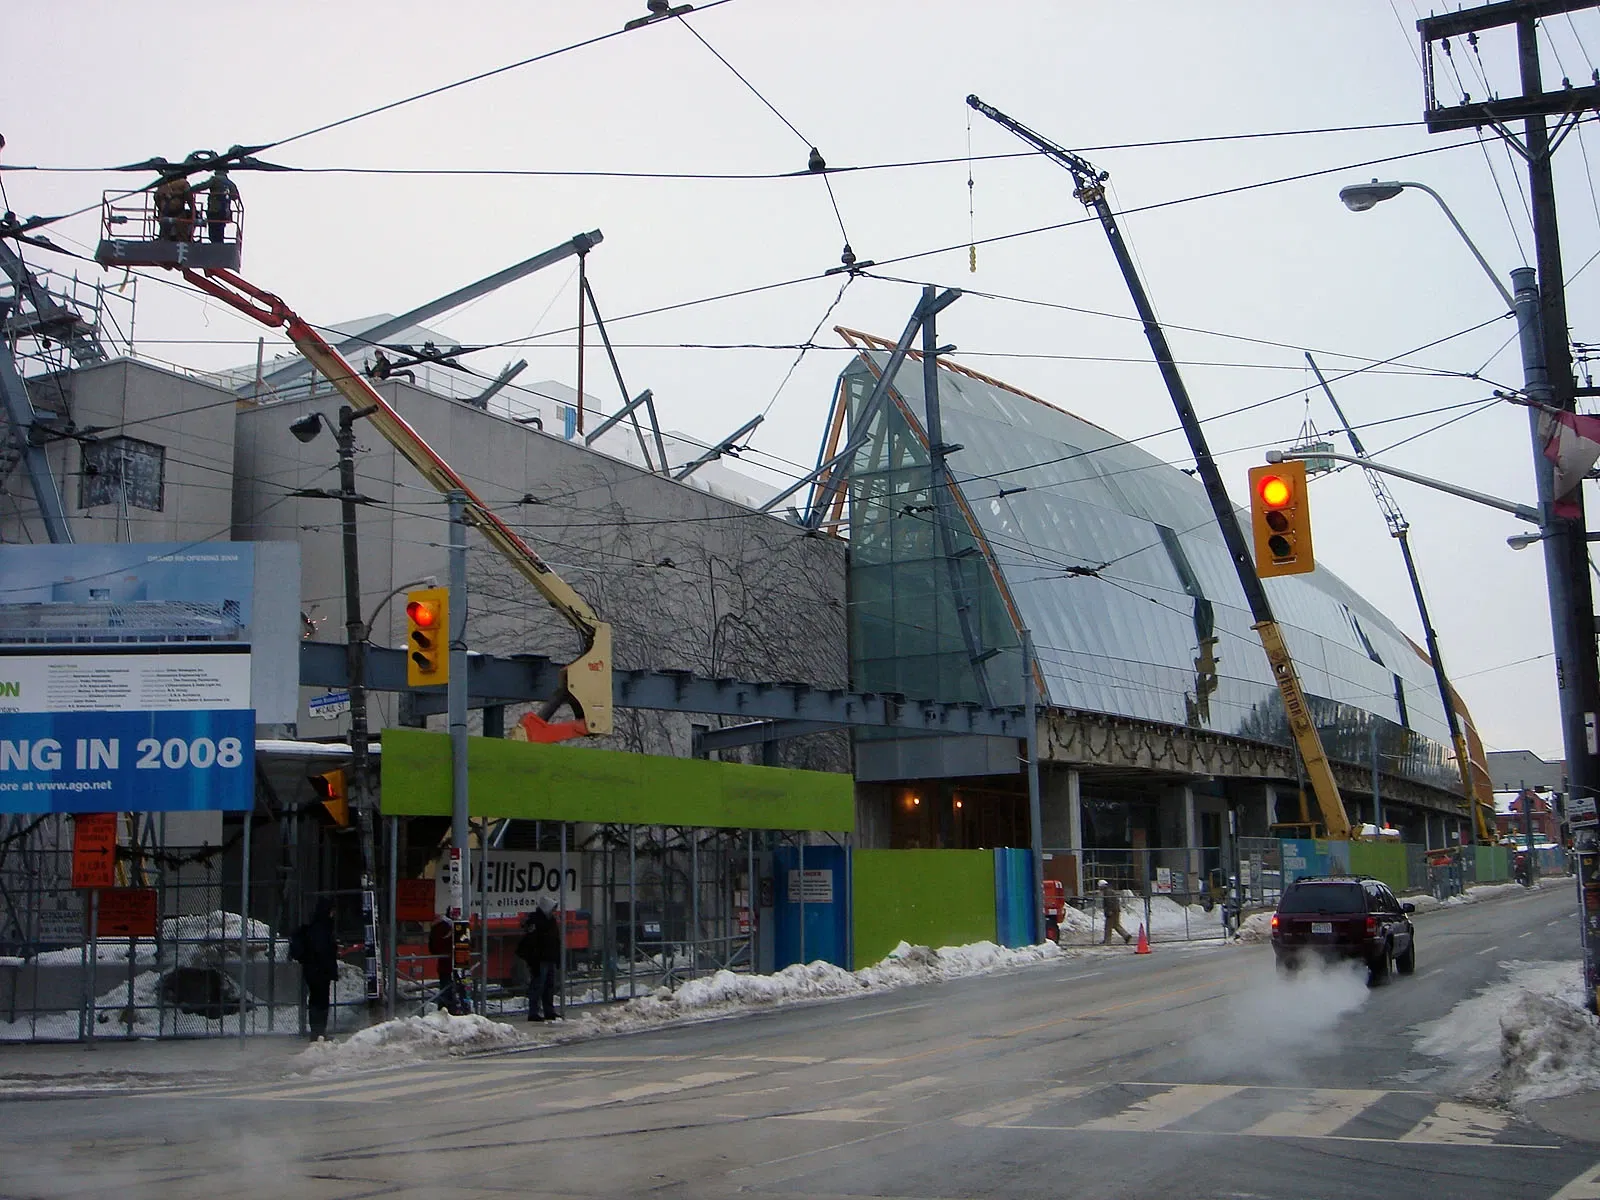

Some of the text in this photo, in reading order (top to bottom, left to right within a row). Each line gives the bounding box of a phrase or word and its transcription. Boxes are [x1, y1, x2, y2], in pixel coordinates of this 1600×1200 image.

[0, 737, 242, 770] NG IN 2008
[22, 781, 34, 791] at
[37, 780, 112, 792] www.ago.net
[477, 861, 577, 893] EllisDon
